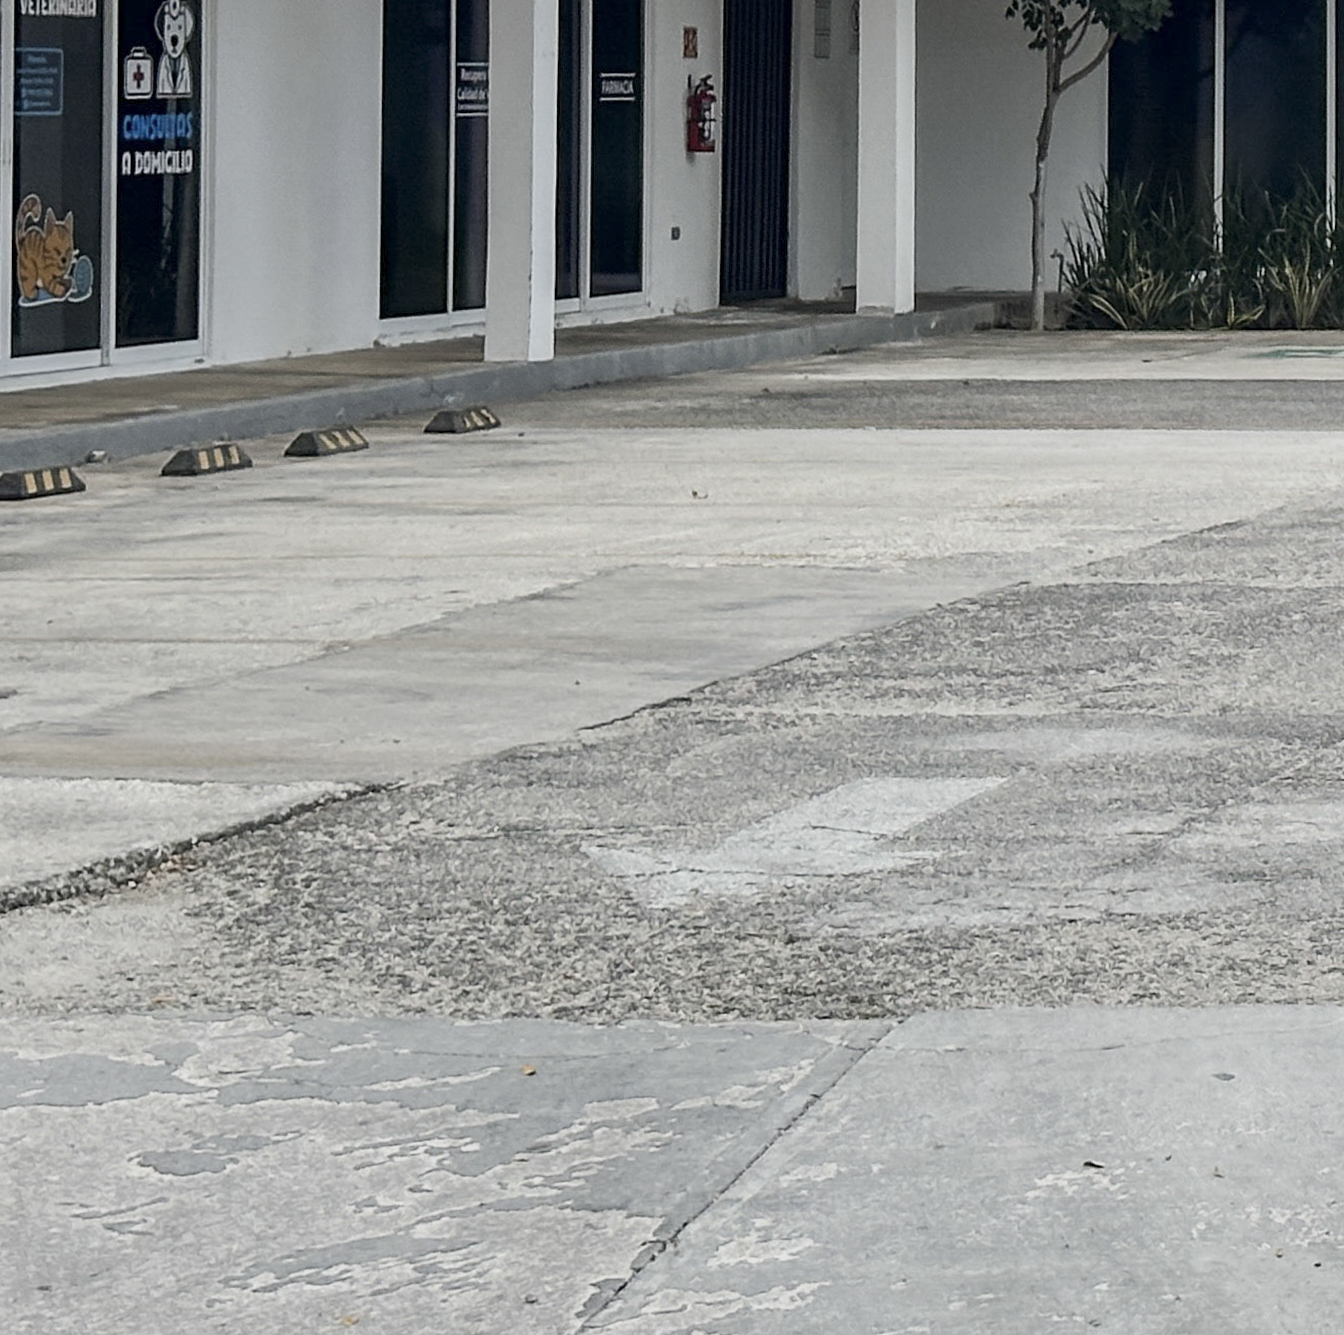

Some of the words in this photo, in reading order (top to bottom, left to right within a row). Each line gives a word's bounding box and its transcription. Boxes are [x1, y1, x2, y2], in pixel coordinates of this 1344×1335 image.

[123, 111, 194, 141] CONSULTAS
[122, 151, 132, 175] A
[134, 149, 194, 175] DOMICILIO
